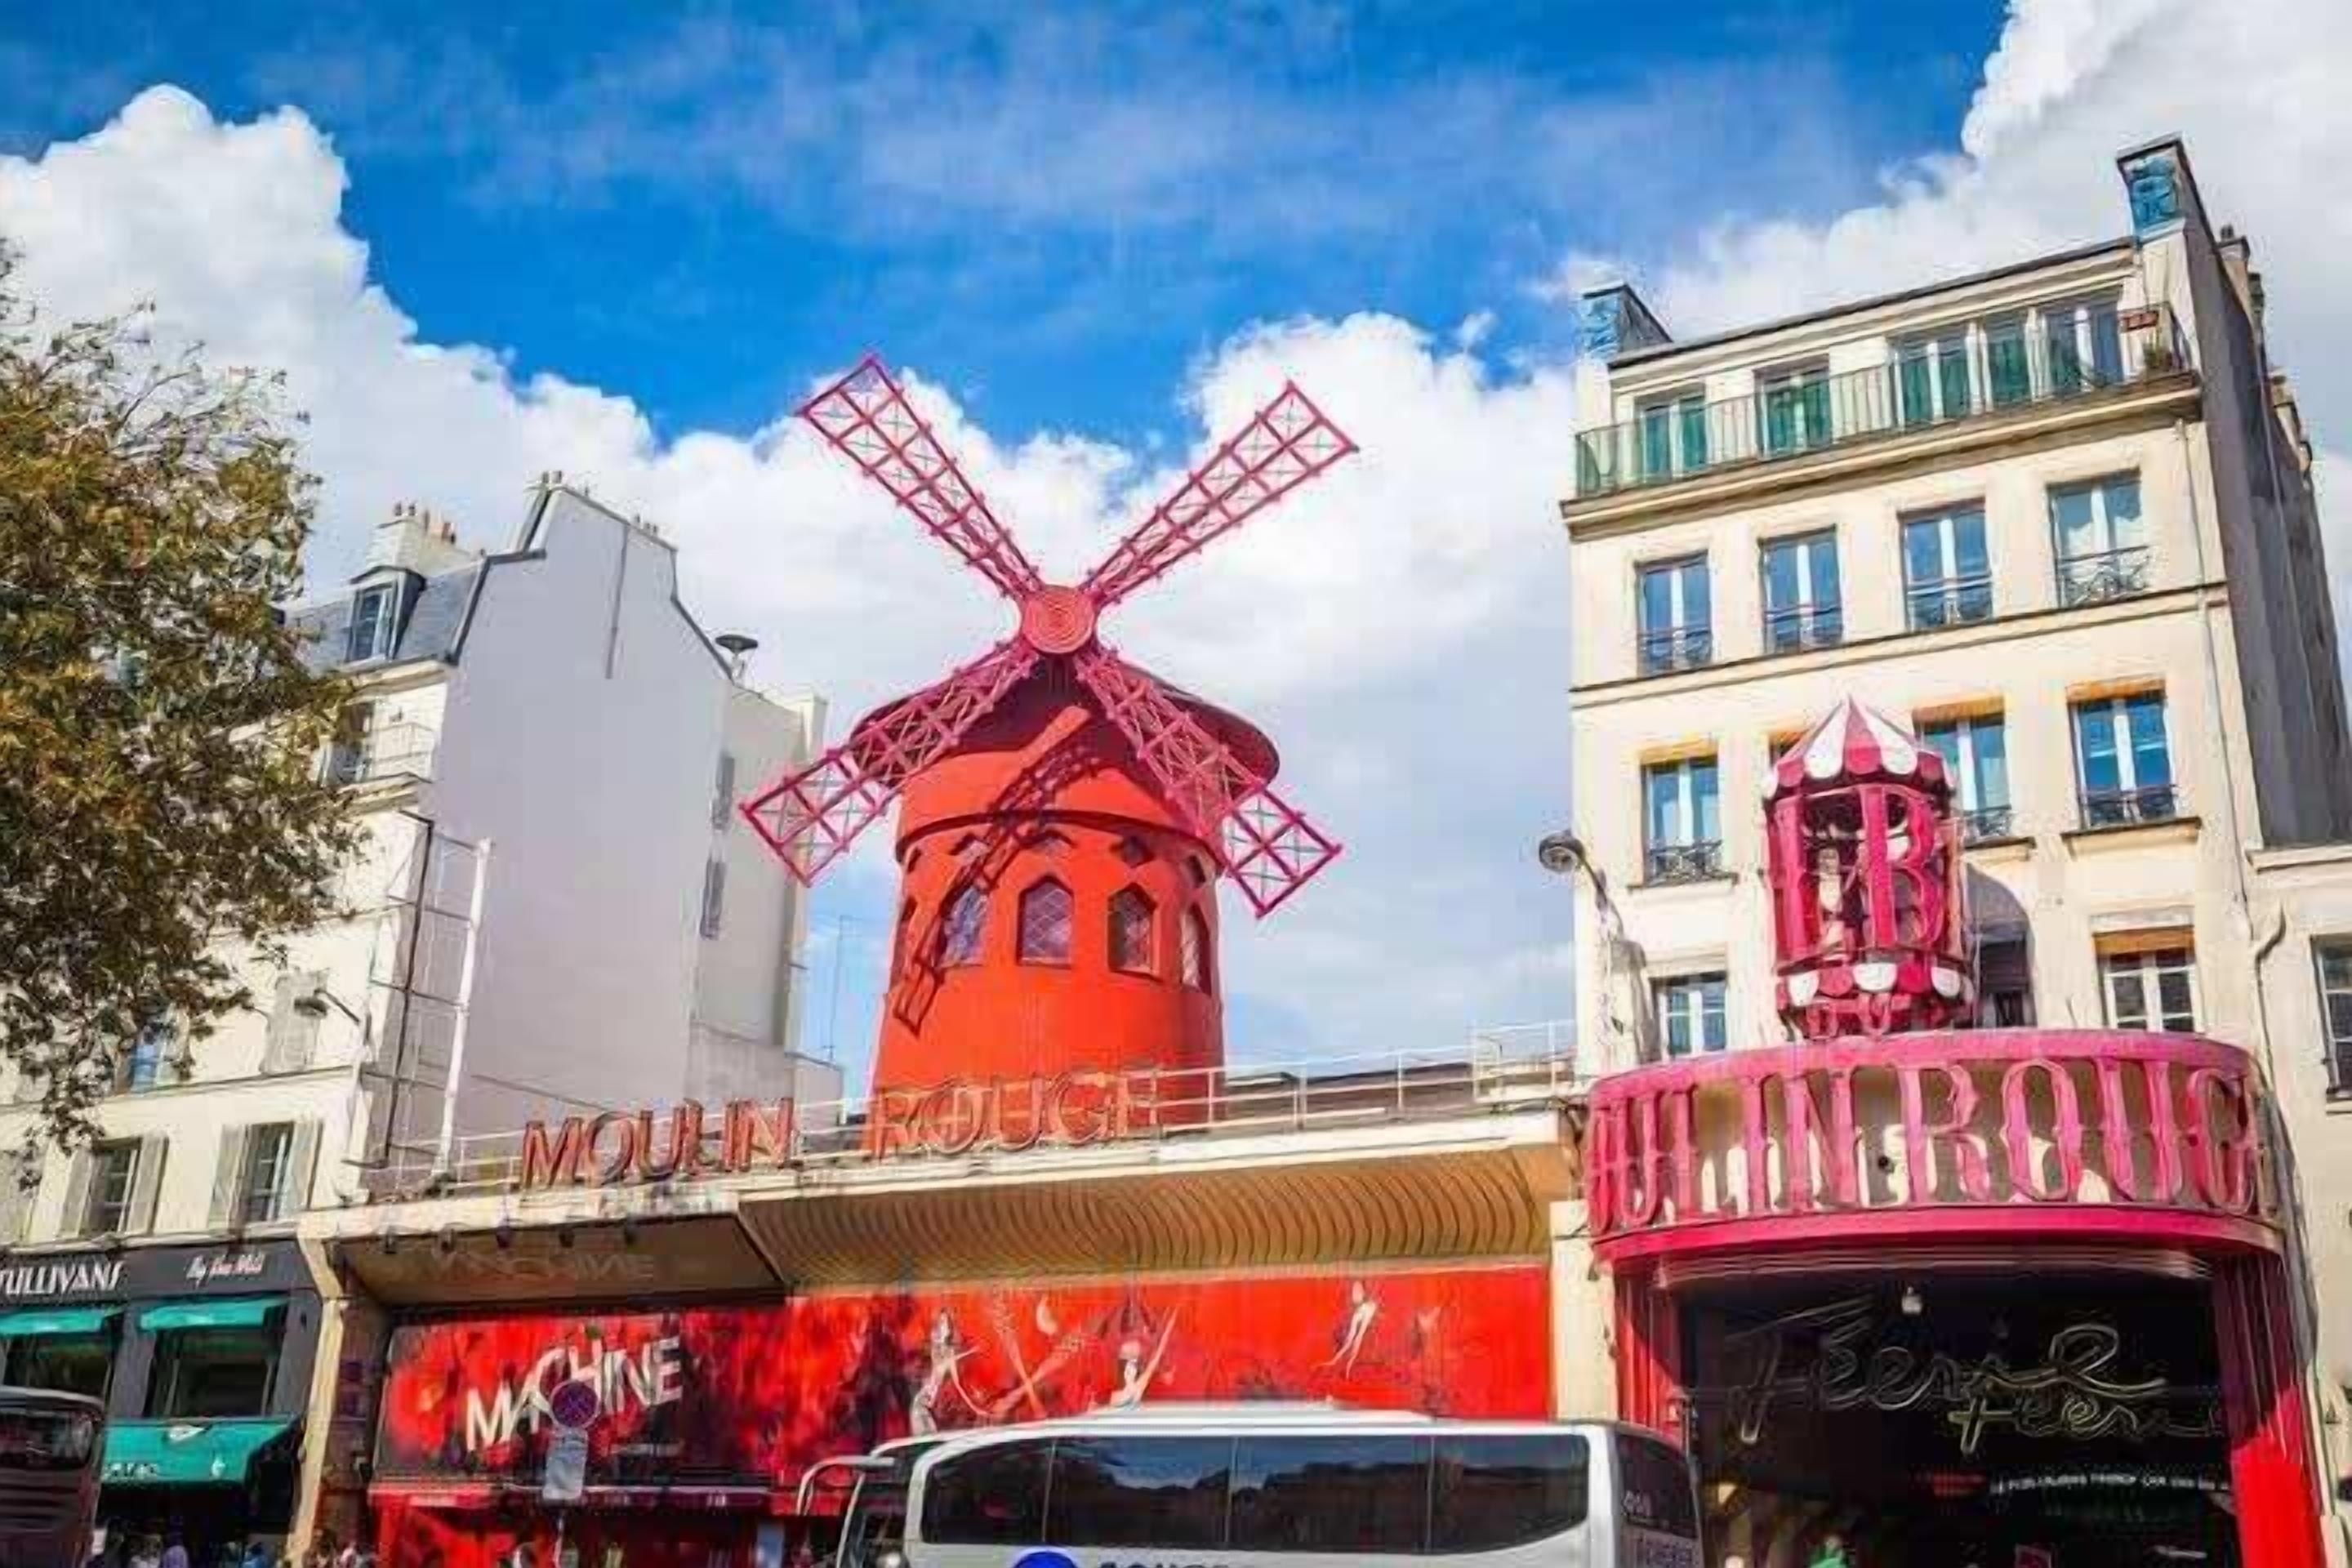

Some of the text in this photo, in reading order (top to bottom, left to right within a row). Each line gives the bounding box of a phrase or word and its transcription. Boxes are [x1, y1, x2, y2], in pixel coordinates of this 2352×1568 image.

[522, 1096, 794, 1190] MOULIN
[1893, 1058, 2278, 1218] ROUG
[466, 1334, 683, 1453] MACHINE
